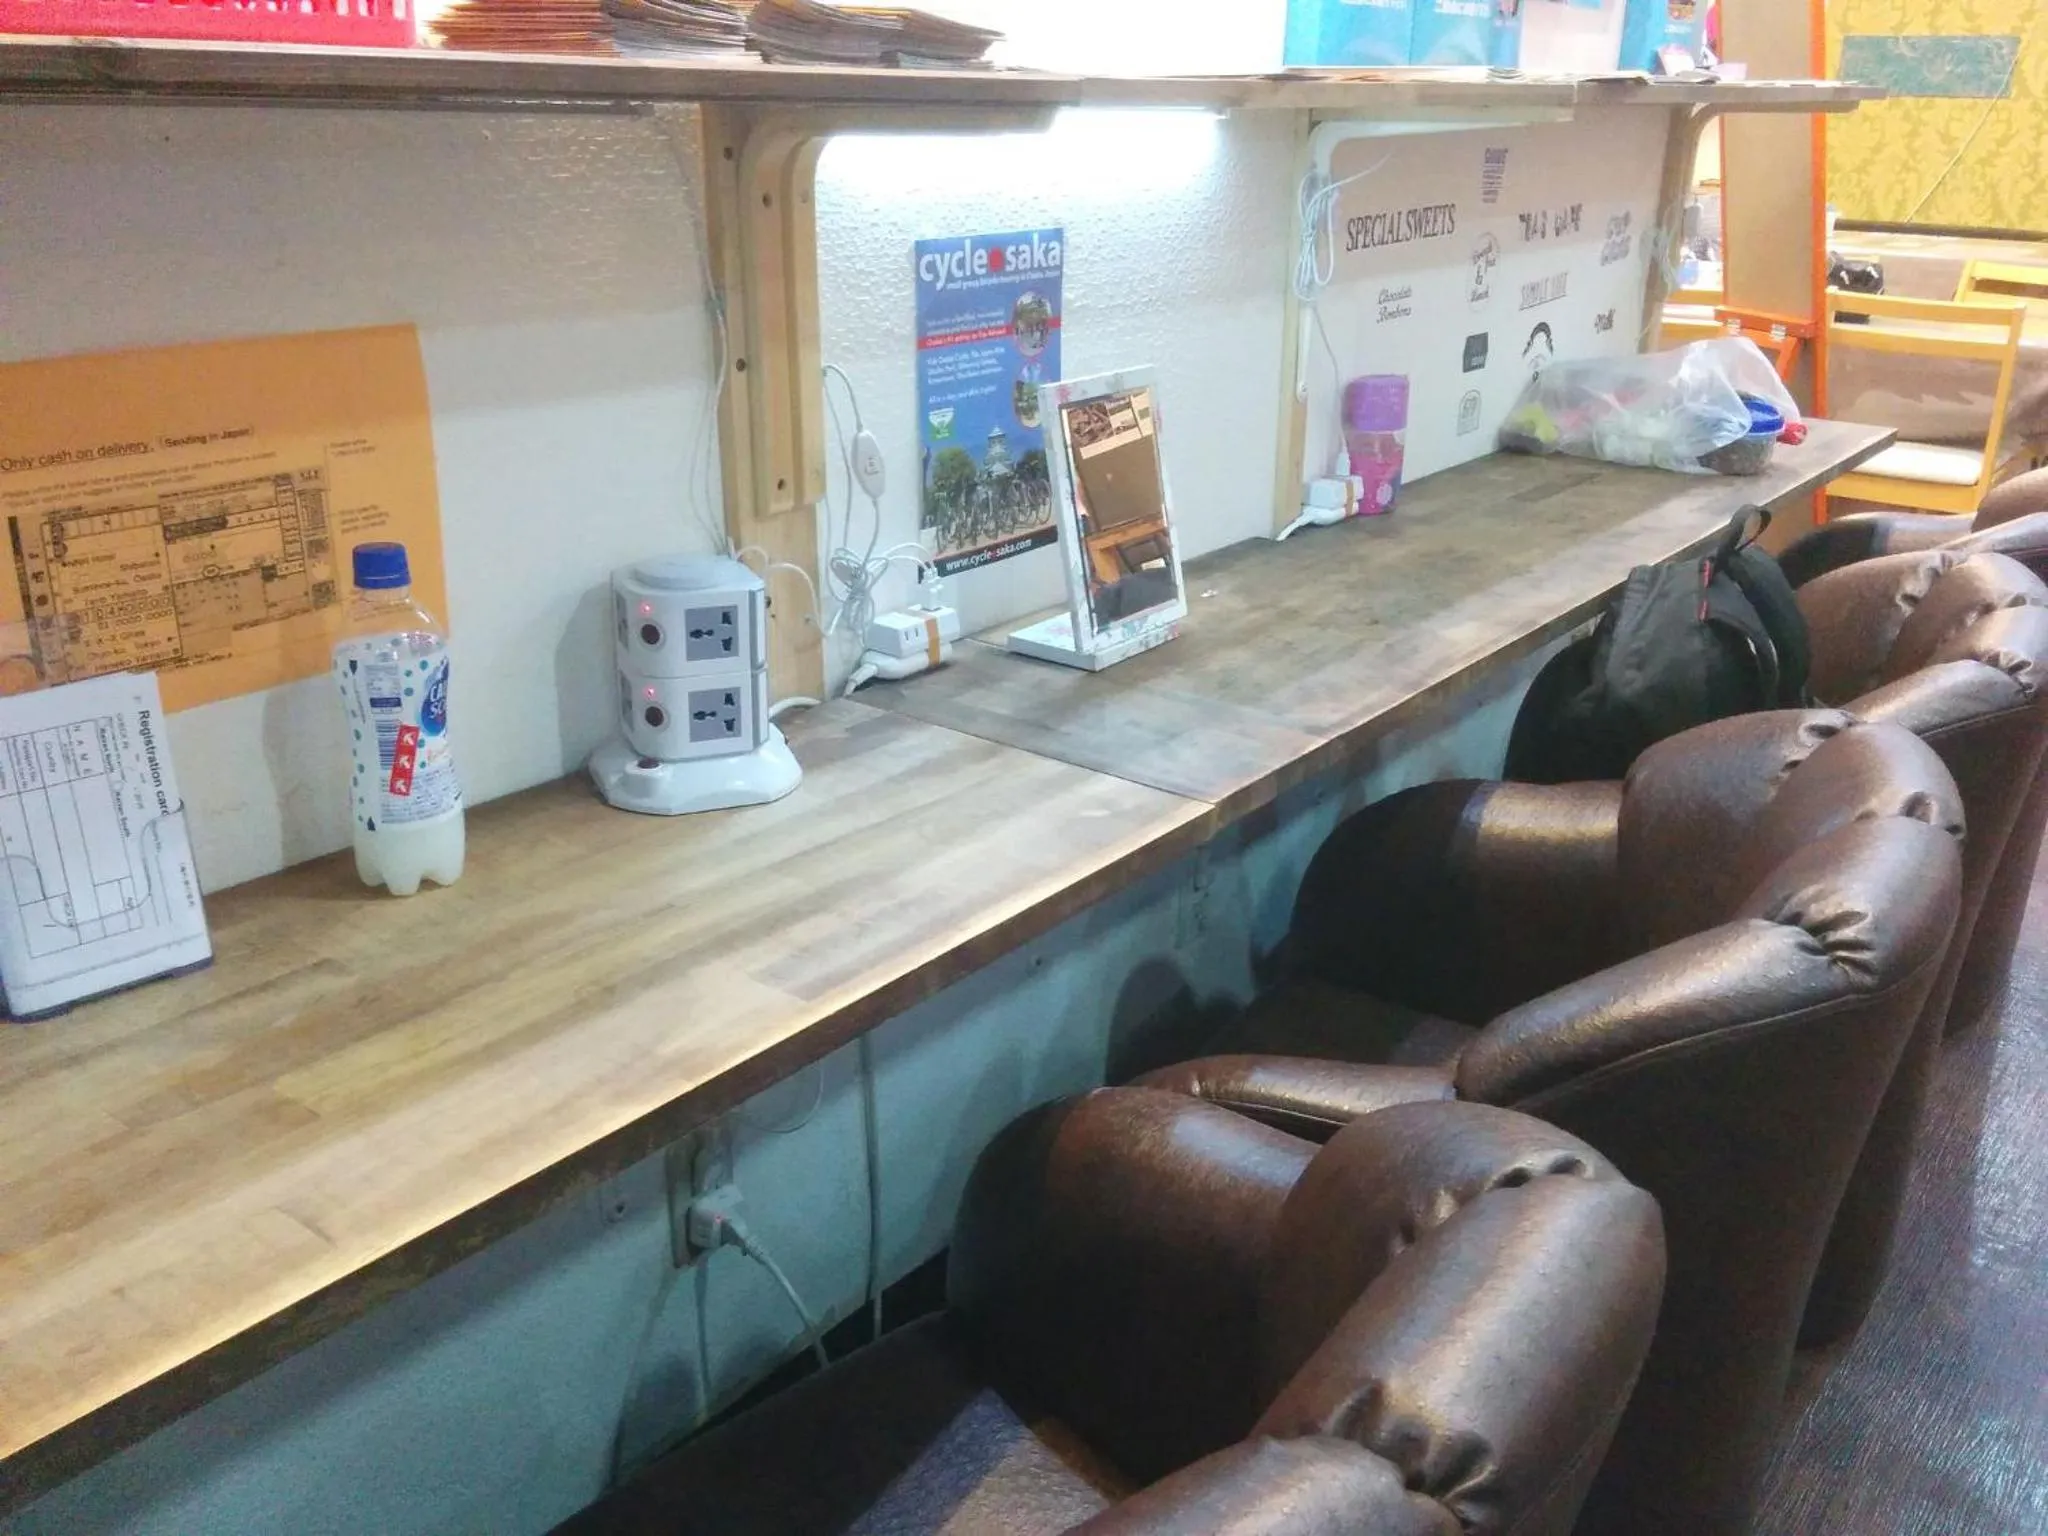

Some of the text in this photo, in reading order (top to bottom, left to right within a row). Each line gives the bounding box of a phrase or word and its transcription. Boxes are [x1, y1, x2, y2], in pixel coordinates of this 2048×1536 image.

[1345, 203, 1456, 252] SPECIAL SWEETS
[0, 457, 33, 471] Only
[38, 447, 72, 467] cash
[138, 709, 163, 788] Registration
